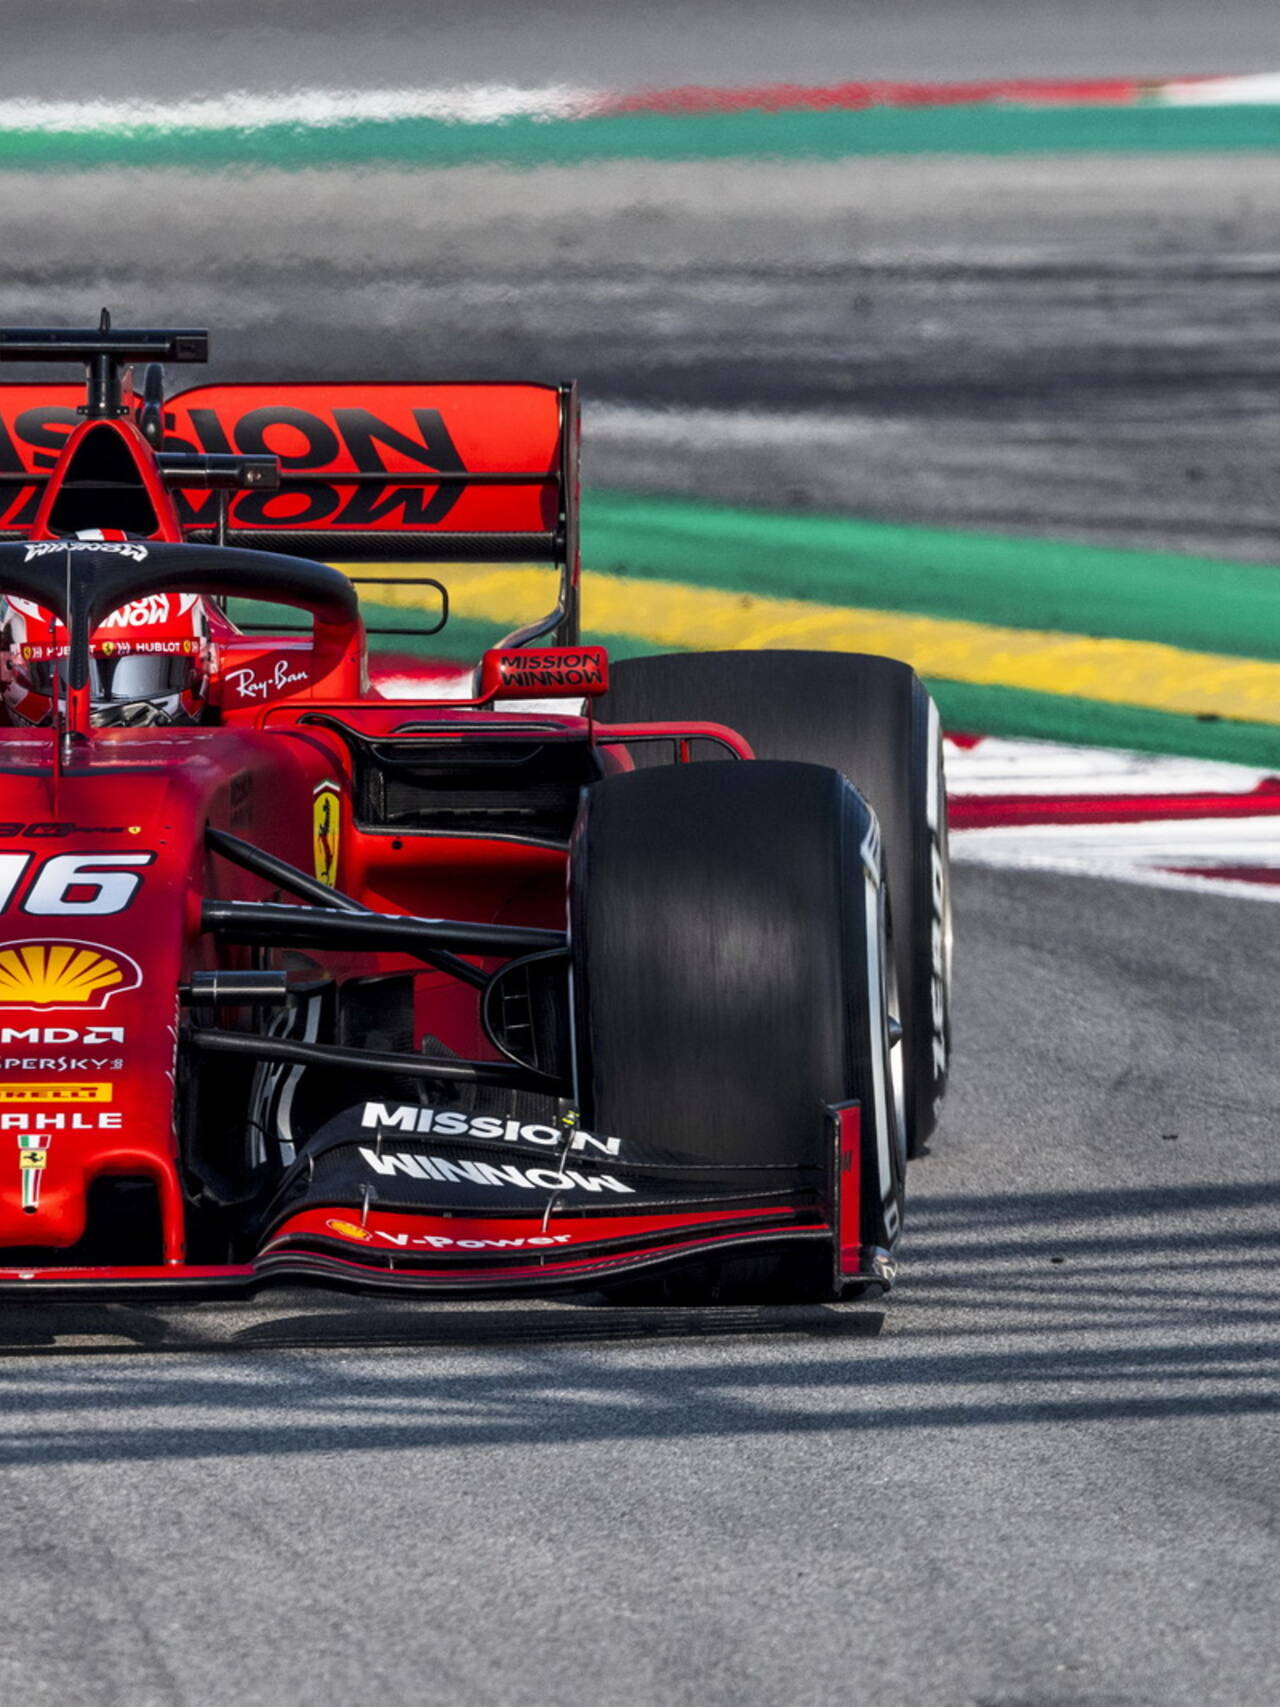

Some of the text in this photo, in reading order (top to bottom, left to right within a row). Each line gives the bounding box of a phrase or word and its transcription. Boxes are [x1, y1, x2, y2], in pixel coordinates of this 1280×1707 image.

[136, 642, 180, 652] HUBLOT
[501, 653, 600, 669] MISSION
[225, 660, 308, 698] Ray-Ban
[501, 669, 602, 686] WINNOW
[361, 1102, 621, 1156] MISSION
[358, 1147, 636, 1193] WINNOW
[375, 1231, 572, 1248] V-Power
